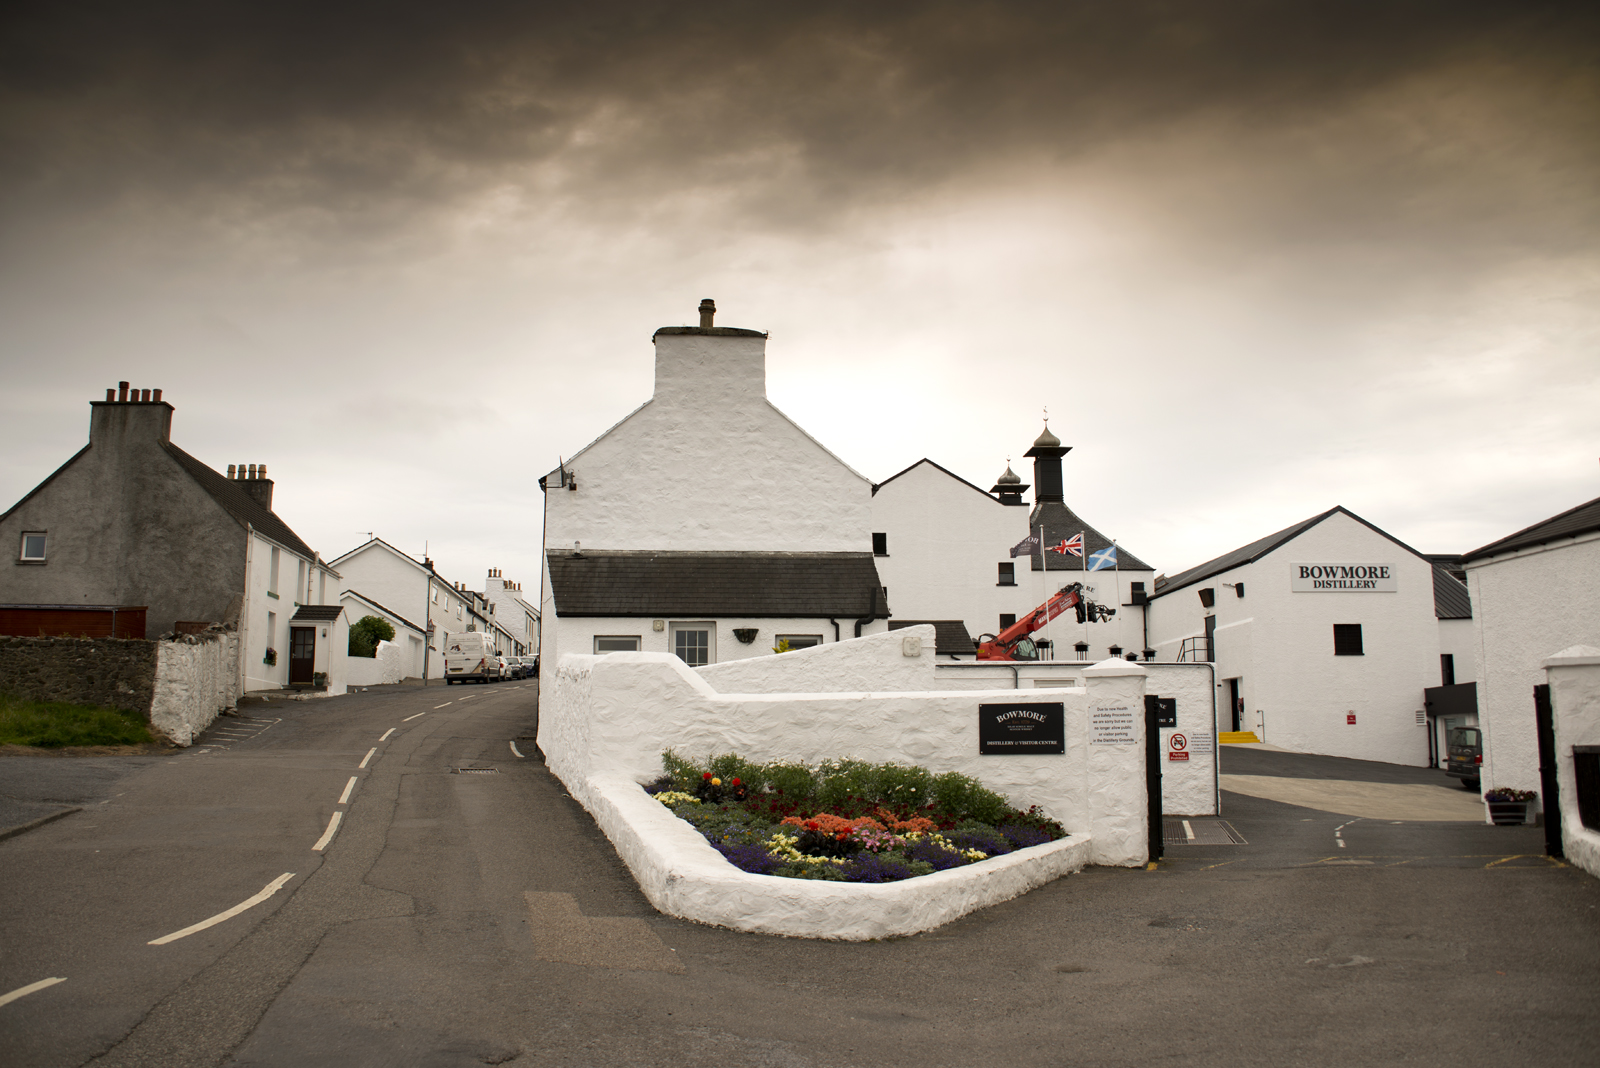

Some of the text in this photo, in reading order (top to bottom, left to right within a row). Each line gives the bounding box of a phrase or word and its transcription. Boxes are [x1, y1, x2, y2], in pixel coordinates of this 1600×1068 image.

[1298, 566, 1390, 579] BOWMORE
[1313, 580, 1377, 588] DISTILLERY
[996, 710, 1046, 723] BOWMORE
